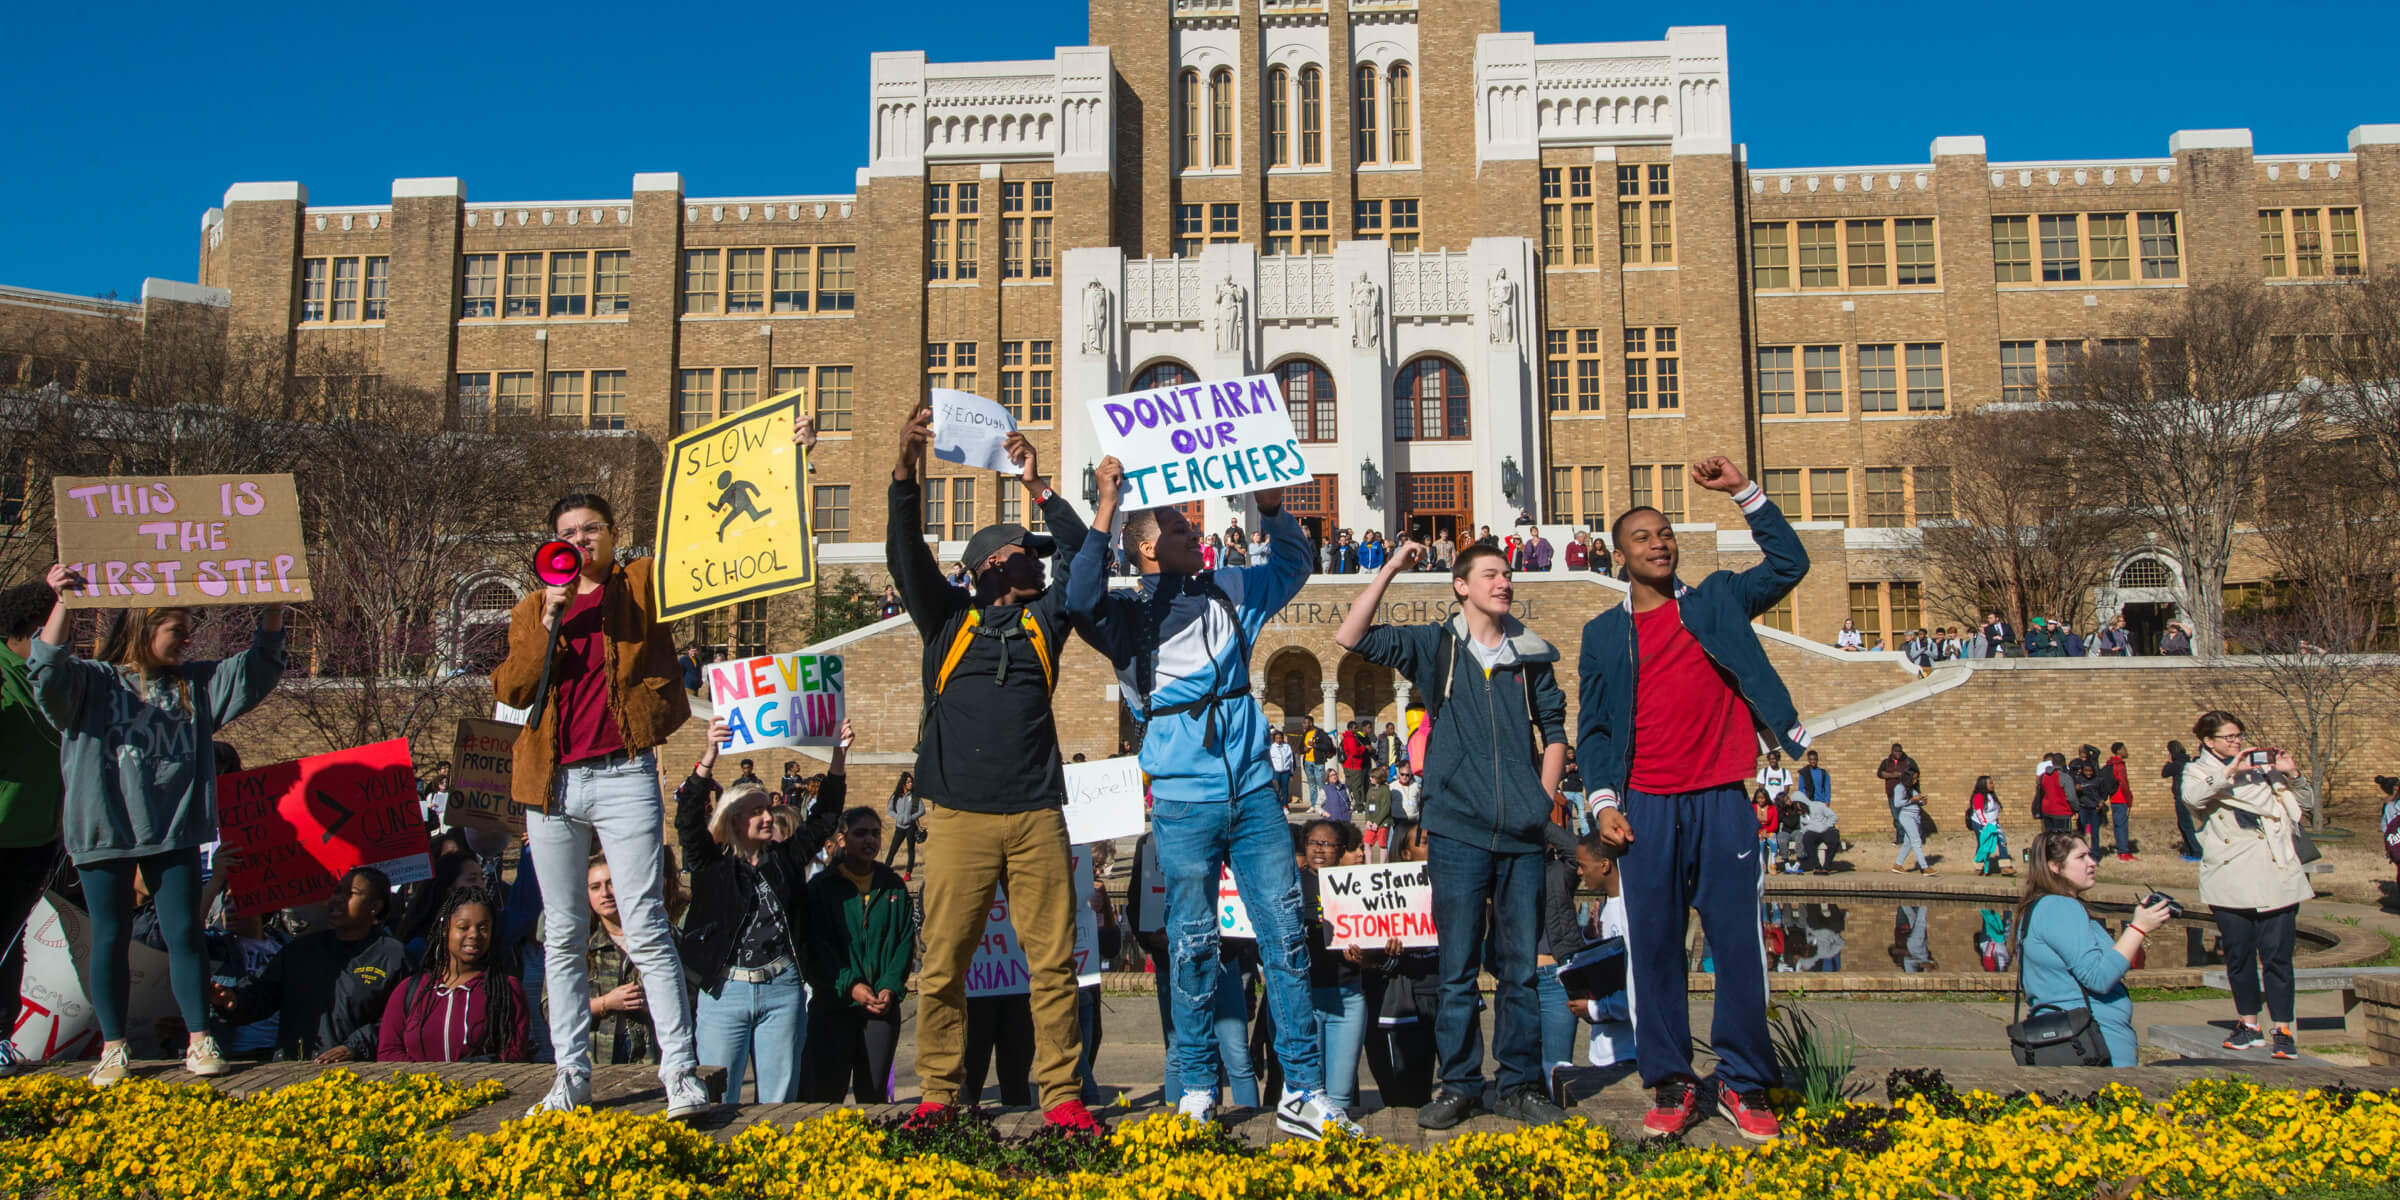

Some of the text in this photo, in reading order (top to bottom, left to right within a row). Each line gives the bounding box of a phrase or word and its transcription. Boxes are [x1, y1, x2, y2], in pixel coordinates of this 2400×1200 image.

[1208, 379, 1277, 420] ARM
[686, 418, 771, 476] SLOW
[1170, 421, 1238, 454] OUR
[1123, 438, 1305, 505] TEACHERS
[67, 481, 267, 518] THIS IS
[137, 521, 231, 553] THE
[193, 554, 303, 598] STEP.
[690, 549, 788, 592] SCHOOL
[711, 655, 843, 705] NEVER
[722, 693, 836, 750] AGAIN
[236, 773, 268, 801] MY
[356, 770, 411, 803] YOUR
[468, 792, 505, 811] NOT
[240, 824, 267, 845] TO
[1327, 872, 1362, 896] We
[1362, 890, 1407, 911] with
